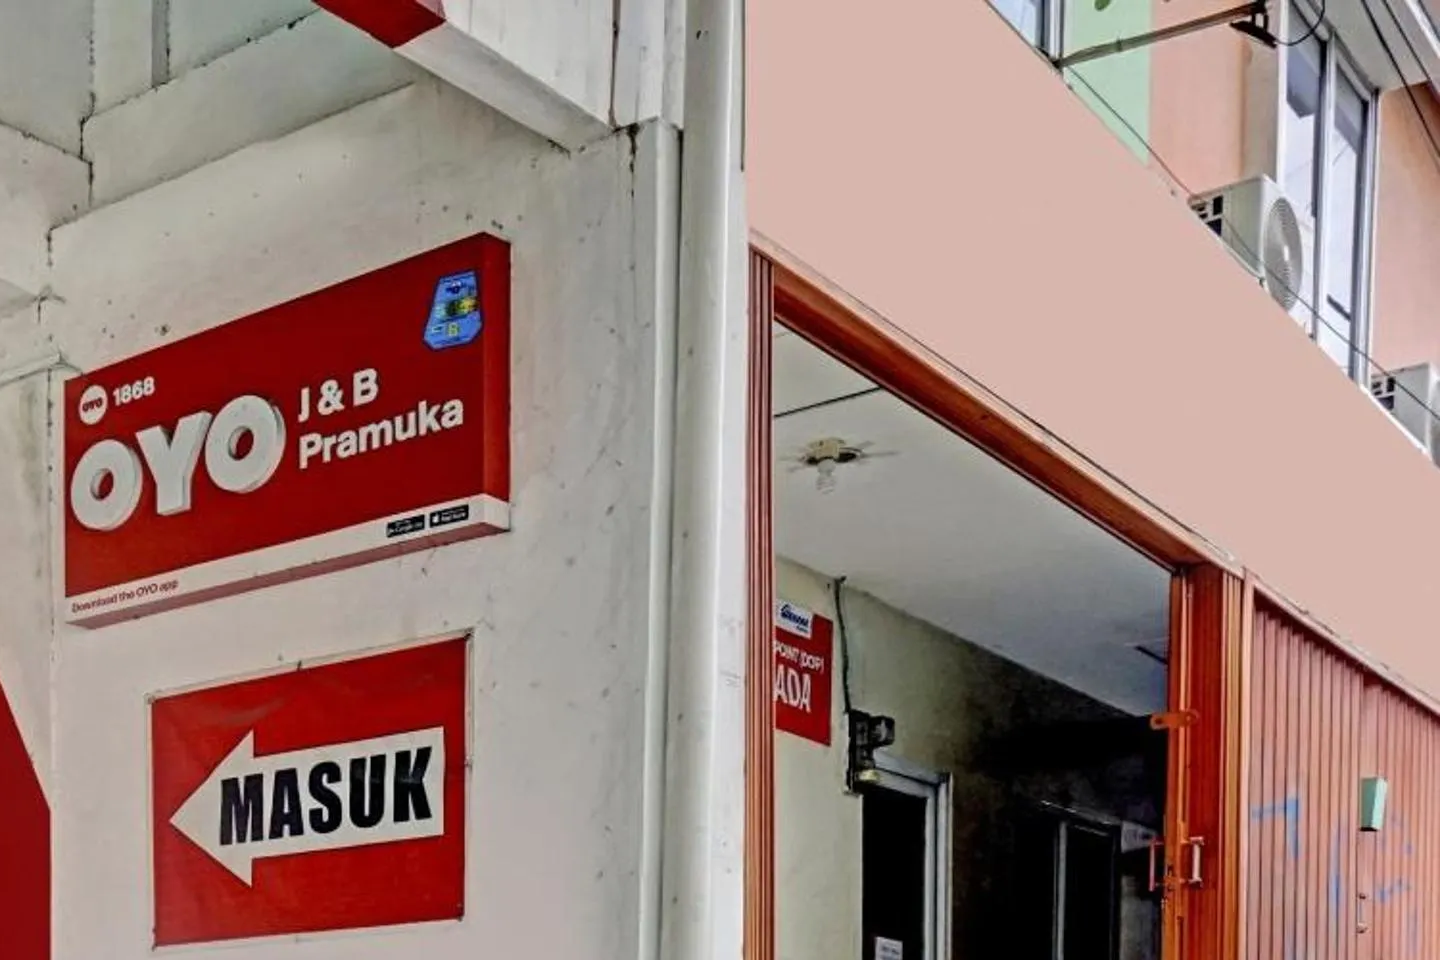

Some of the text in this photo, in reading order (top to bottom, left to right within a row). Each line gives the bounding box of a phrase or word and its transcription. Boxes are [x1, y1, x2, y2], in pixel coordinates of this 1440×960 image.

[81, 376, 156, 413] OYO 1868
[298, 368, 380, 423] J & B
[71, 394, 287, 532] OYO
[298, 399, 464, 469] Pramuka
[71, 593, 118, 613] Download
[119, 589, 136, 601] the
[135, 582, 159, 597] OYO
[219, 746, 433, 846] MASUK
